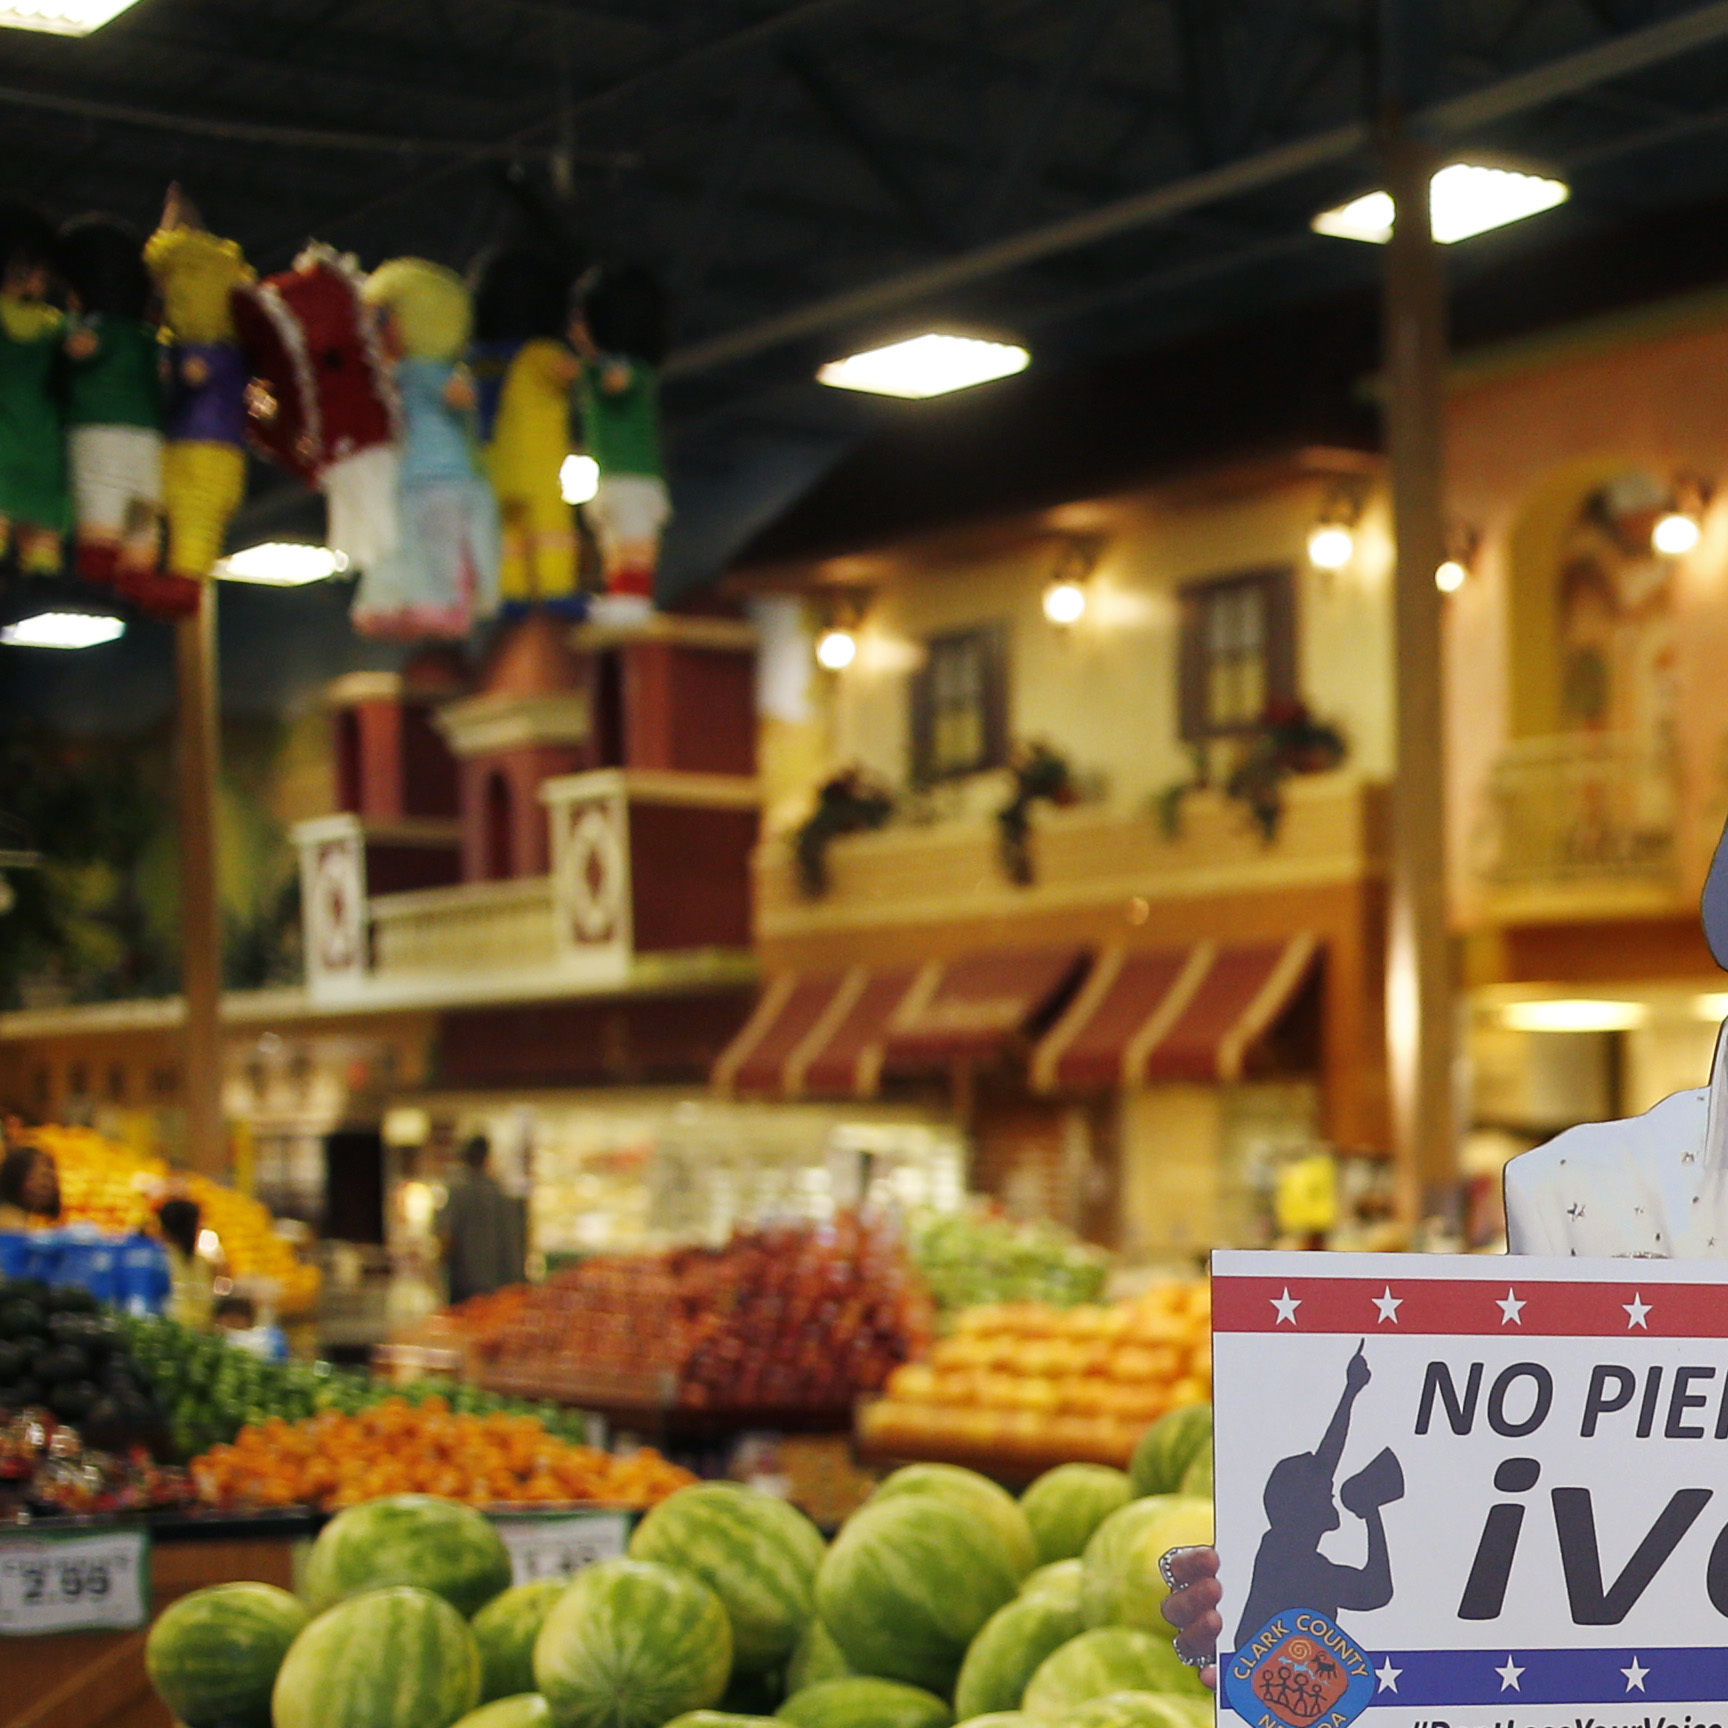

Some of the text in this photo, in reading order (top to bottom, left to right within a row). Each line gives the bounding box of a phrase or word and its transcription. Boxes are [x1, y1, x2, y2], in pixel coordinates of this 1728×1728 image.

[1413, 1360, 1555, 1439] NO
[1233, 1614, 1370, 1681] CLARK COUNTY
